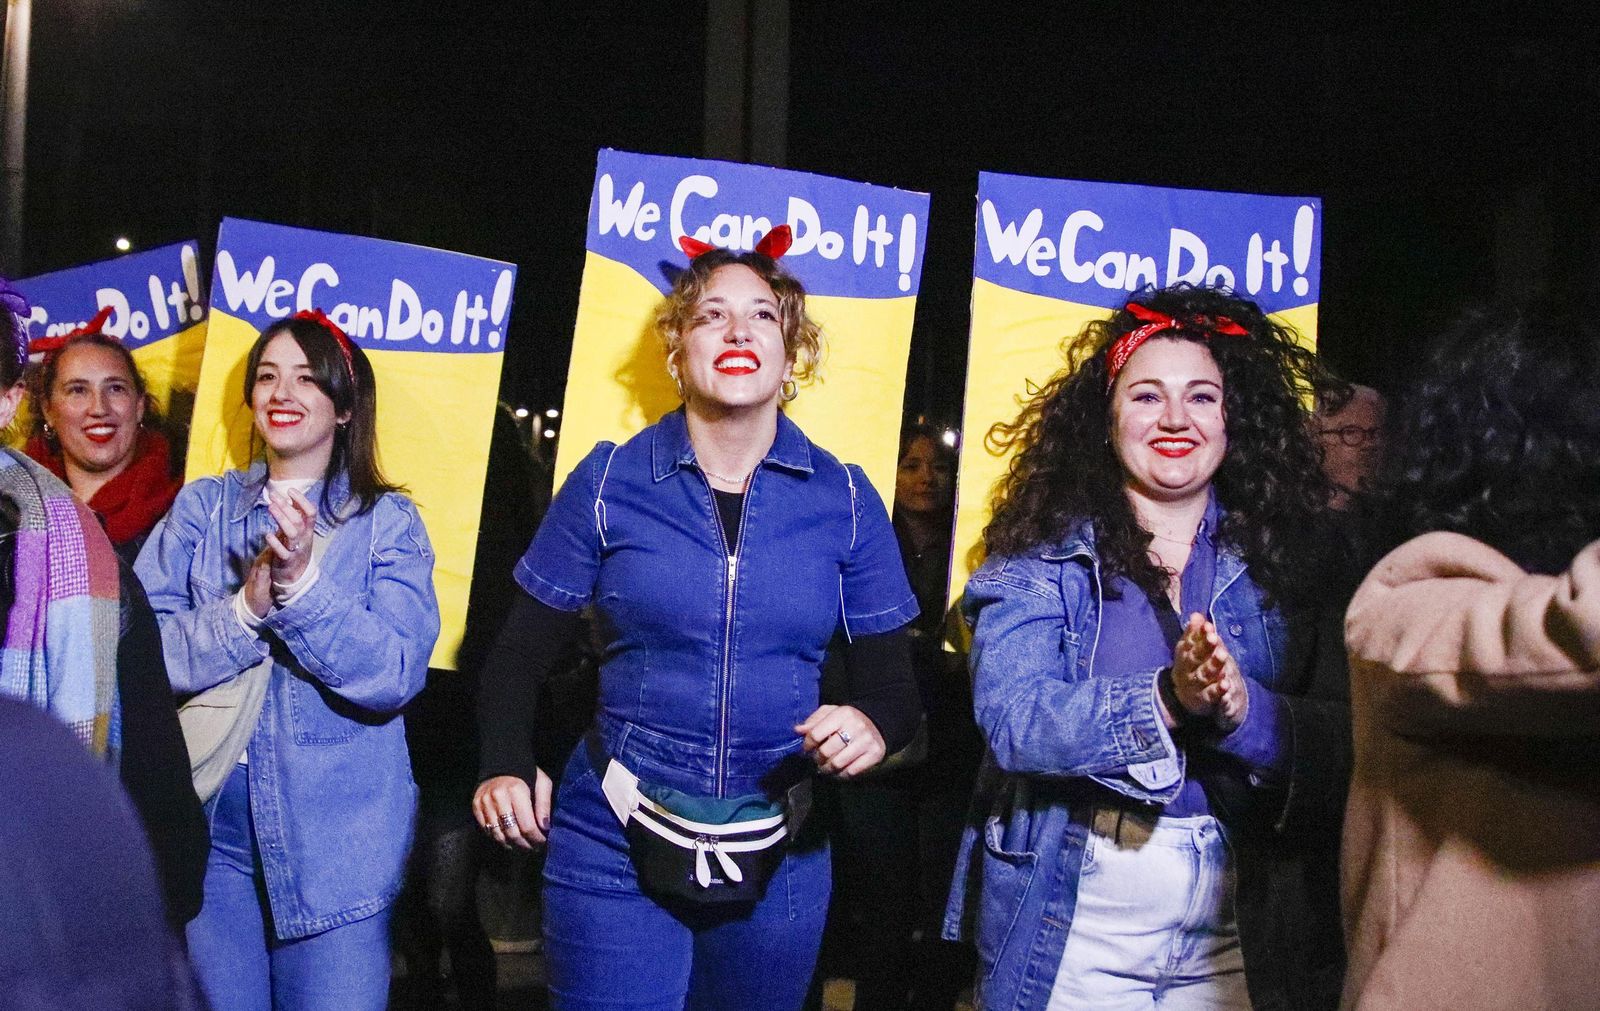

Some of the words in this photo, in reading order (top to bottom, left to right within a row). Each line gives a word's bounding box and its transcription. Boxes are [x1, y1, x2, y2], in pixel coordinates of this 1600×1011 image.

[599, 173, 661, 242] We
[670, 175, 773, 252] Can
[786, 196, 844, 260] Do
[853, 204, 917, 293] It!
[981, 199, 1057, 276] We
[1059, 210, 1157, 292] Can
[1166, 228, 1235, 297] Do
[1246, 204, 1314, 297] It!
[96, 288, 149, 340] Do
[149, 244, 203, 331] It!
[217, 250, 295, 318] We
[297, 262, 383, 340] Can
[386, 278, 444, 345] Do
[451, 269, 512, 349] It!
